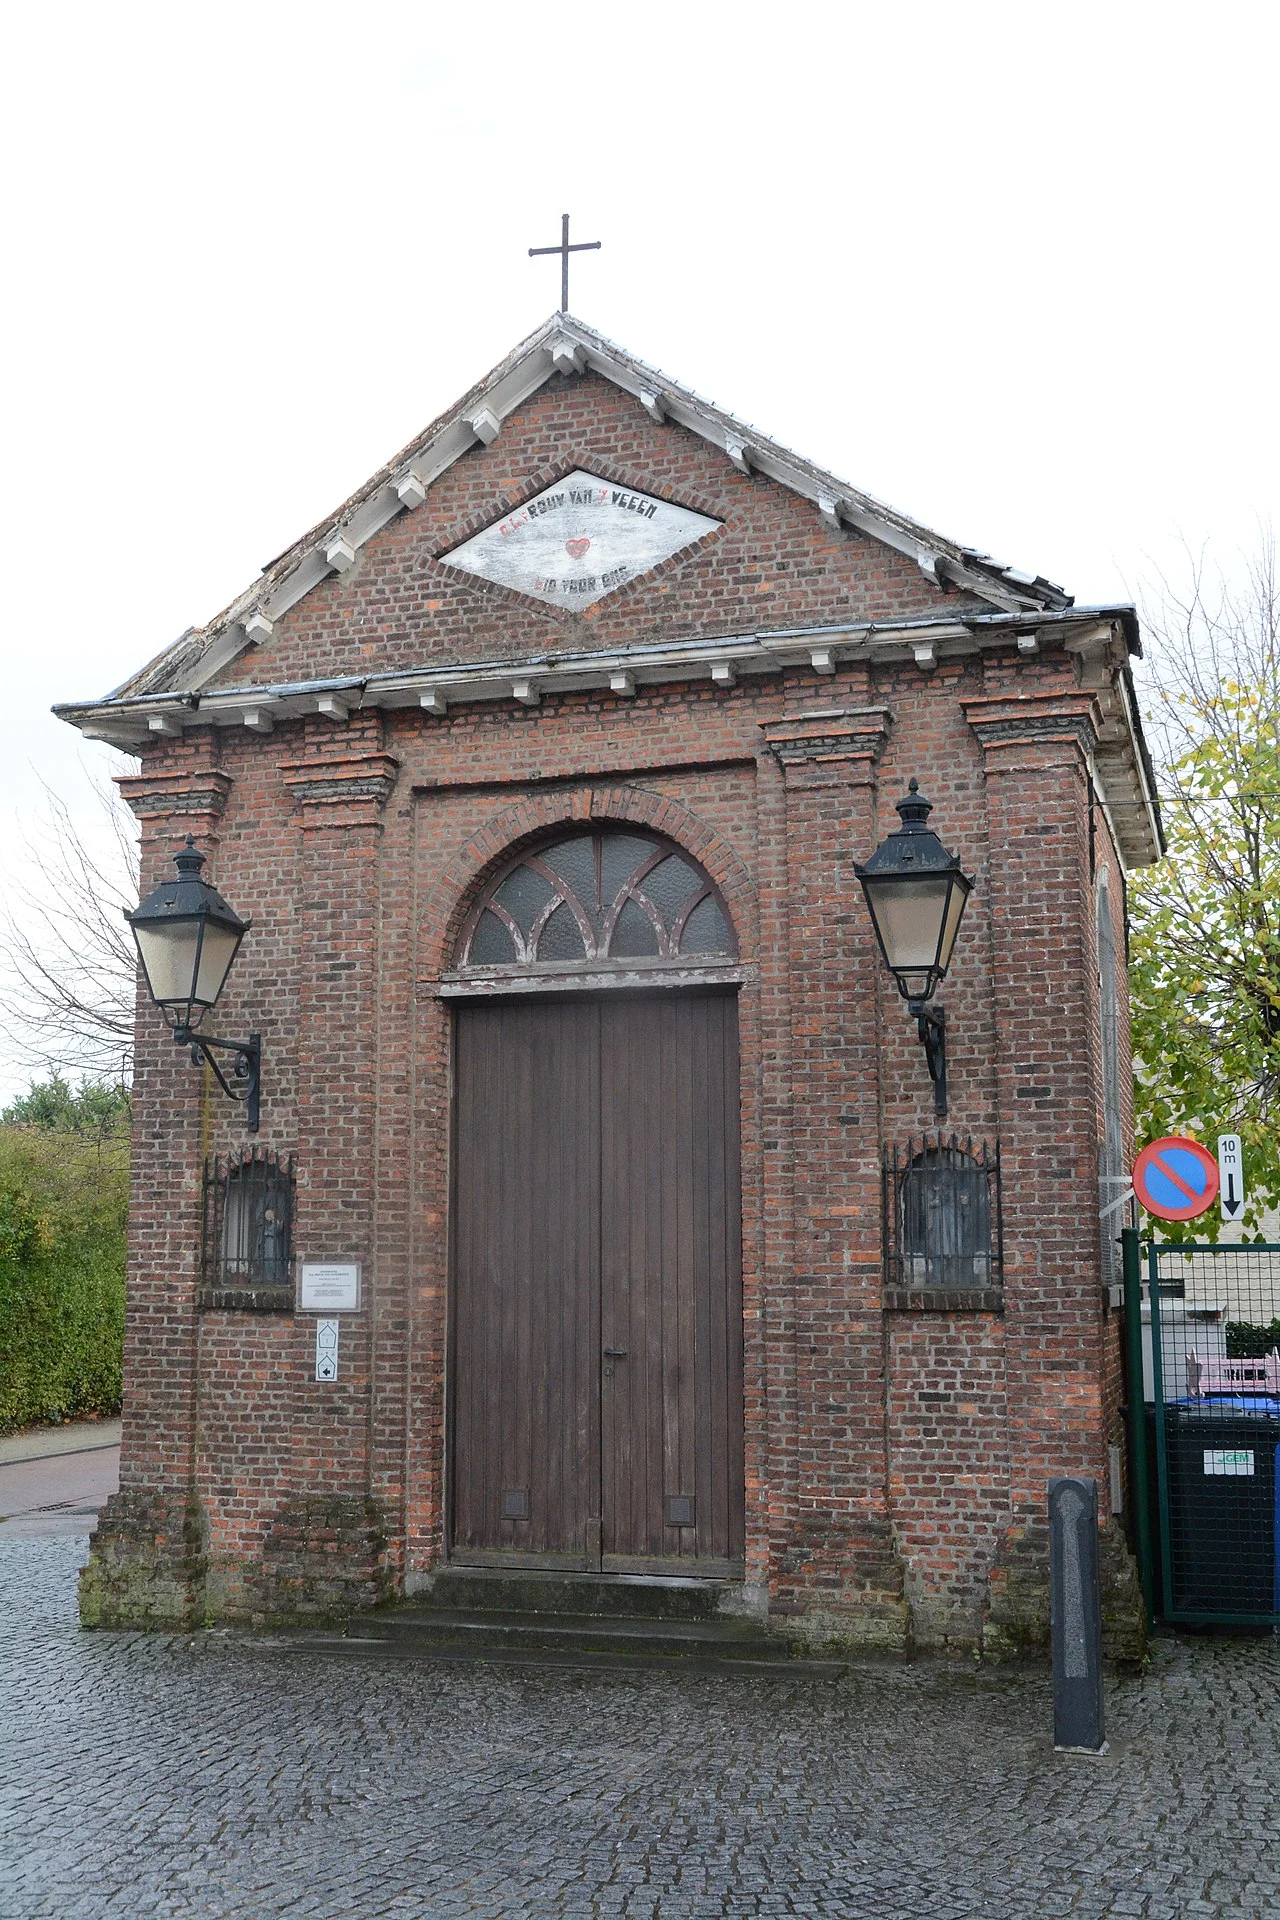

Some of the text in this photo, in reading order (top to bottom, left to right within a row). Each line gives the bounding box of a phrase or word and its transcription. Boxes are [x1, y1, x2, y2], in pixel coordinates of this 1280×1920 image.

[569, 489, 592, 504] VAN
[1221, 1140, 1235, 1152] 10
[1224, 1154, 1236, 1163] m
